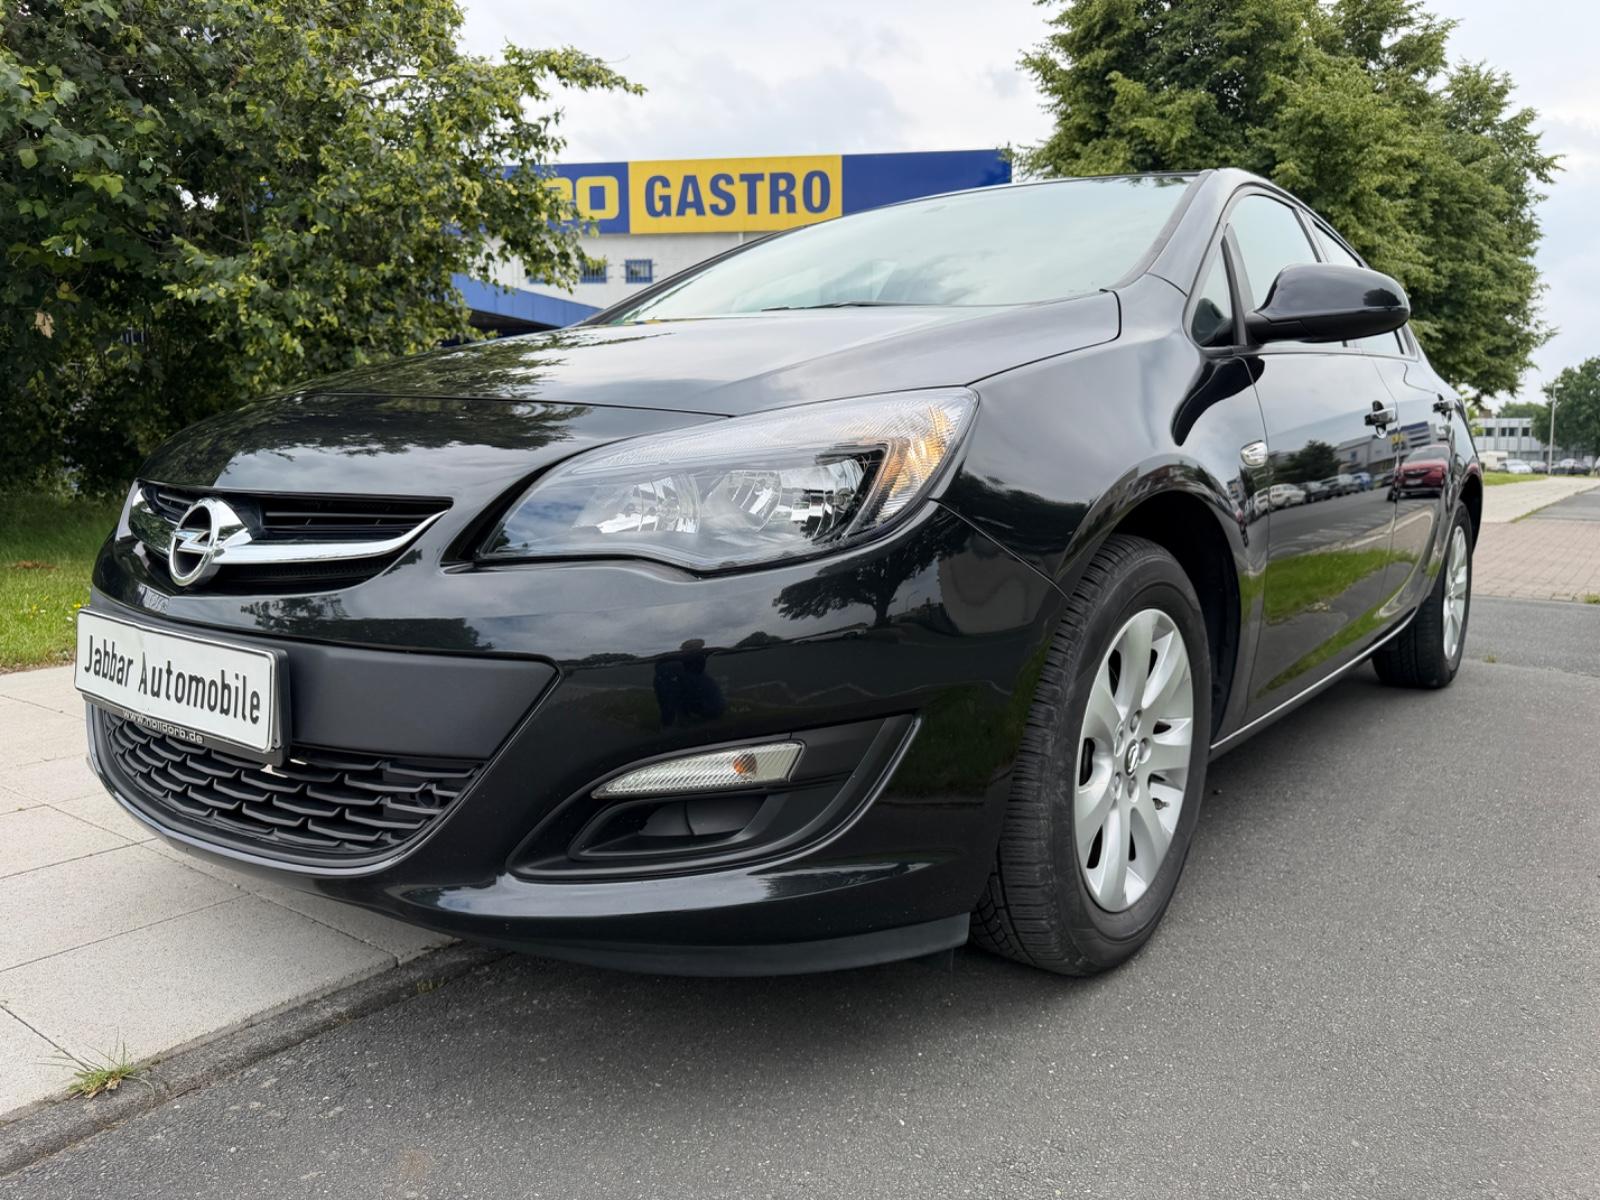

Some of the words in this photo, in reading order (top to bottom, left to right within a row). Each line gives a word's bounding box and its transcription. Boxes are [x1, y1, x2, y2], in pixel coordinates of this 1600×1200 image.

[645, 170, 831, 217] GASTRO
[84, 635, 133, 687] Jabbar
[138, 652, 260, 724] Automobile
